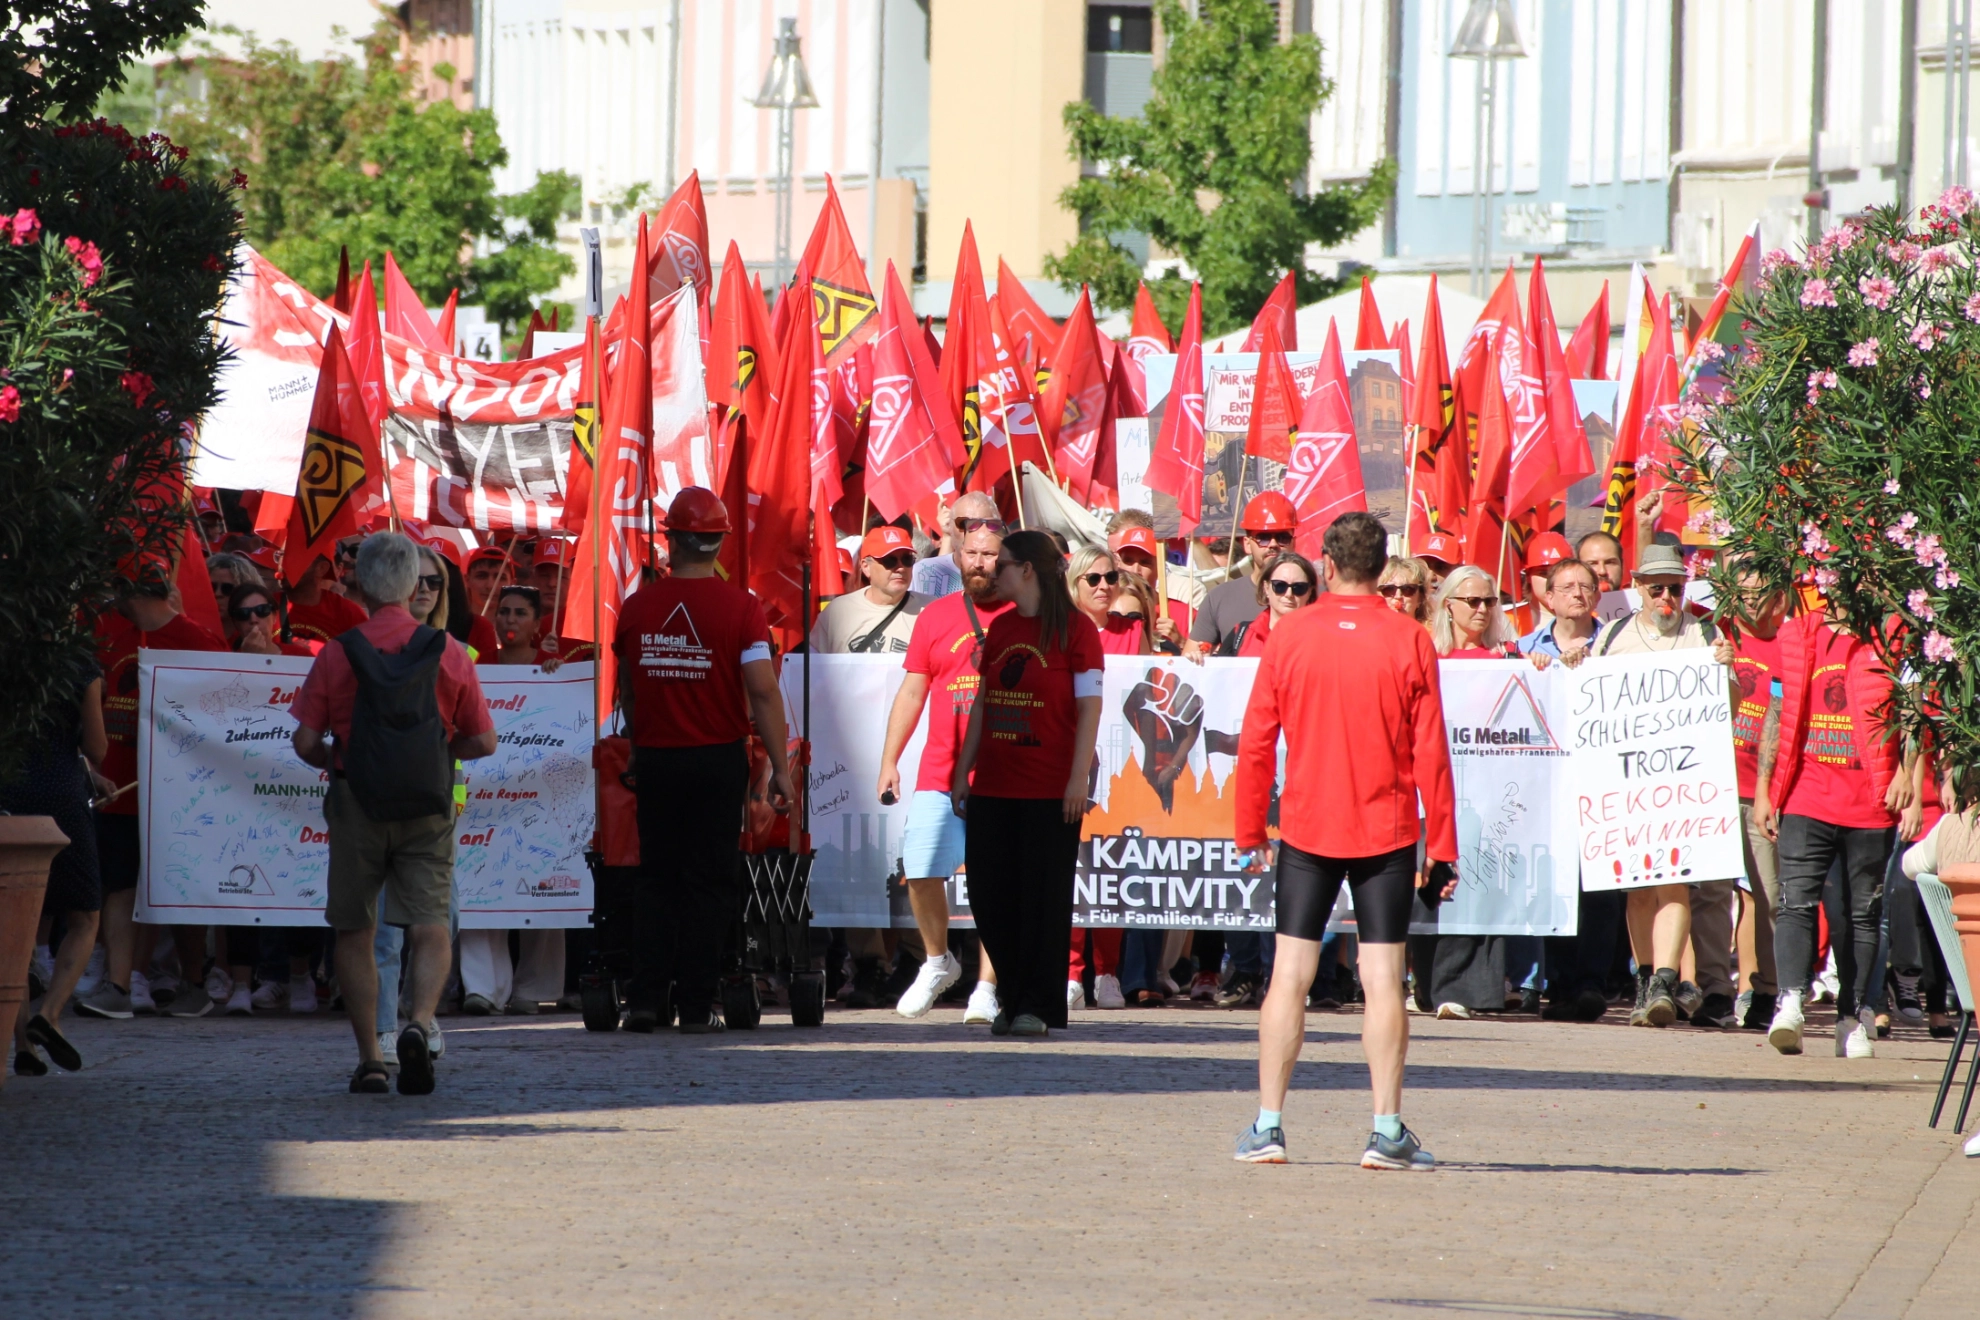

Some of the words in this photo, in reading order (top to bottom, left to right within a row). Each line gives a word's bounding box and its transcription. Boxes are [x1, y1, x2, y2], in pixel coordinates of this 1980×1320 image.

[475, 337, 492, 361] 4
[641, 634, 653, 645] IG
[654, 634, 687, 646] Metall
[1812, 713, 1852, 723] STREIKBER
[1829, 722, 1854, 730] ZUKUN
[1453, 727, 1471, 744] IG
[1475, 727, 1532, 745] Metall
[1452, 747, 1573, 758] Ludwigshafen-Frankentha
[1817, 755, 1847, 764] SPEYER
[1618, 745, 1702, 779] TROTZ
[475, 788, 494, 800] die
[496, 788, 538, 802] Region
[459, 828, 494, 847] an!
[1092, 826, 1245, 873] KÄMPFE
[1073, 873, 1263, 911] NECTIVITY
[1090, 909, 1119, 924] Für
[1124, 909, 1208, 927] Familien.
[1213, 911, 1244, 927] Für
